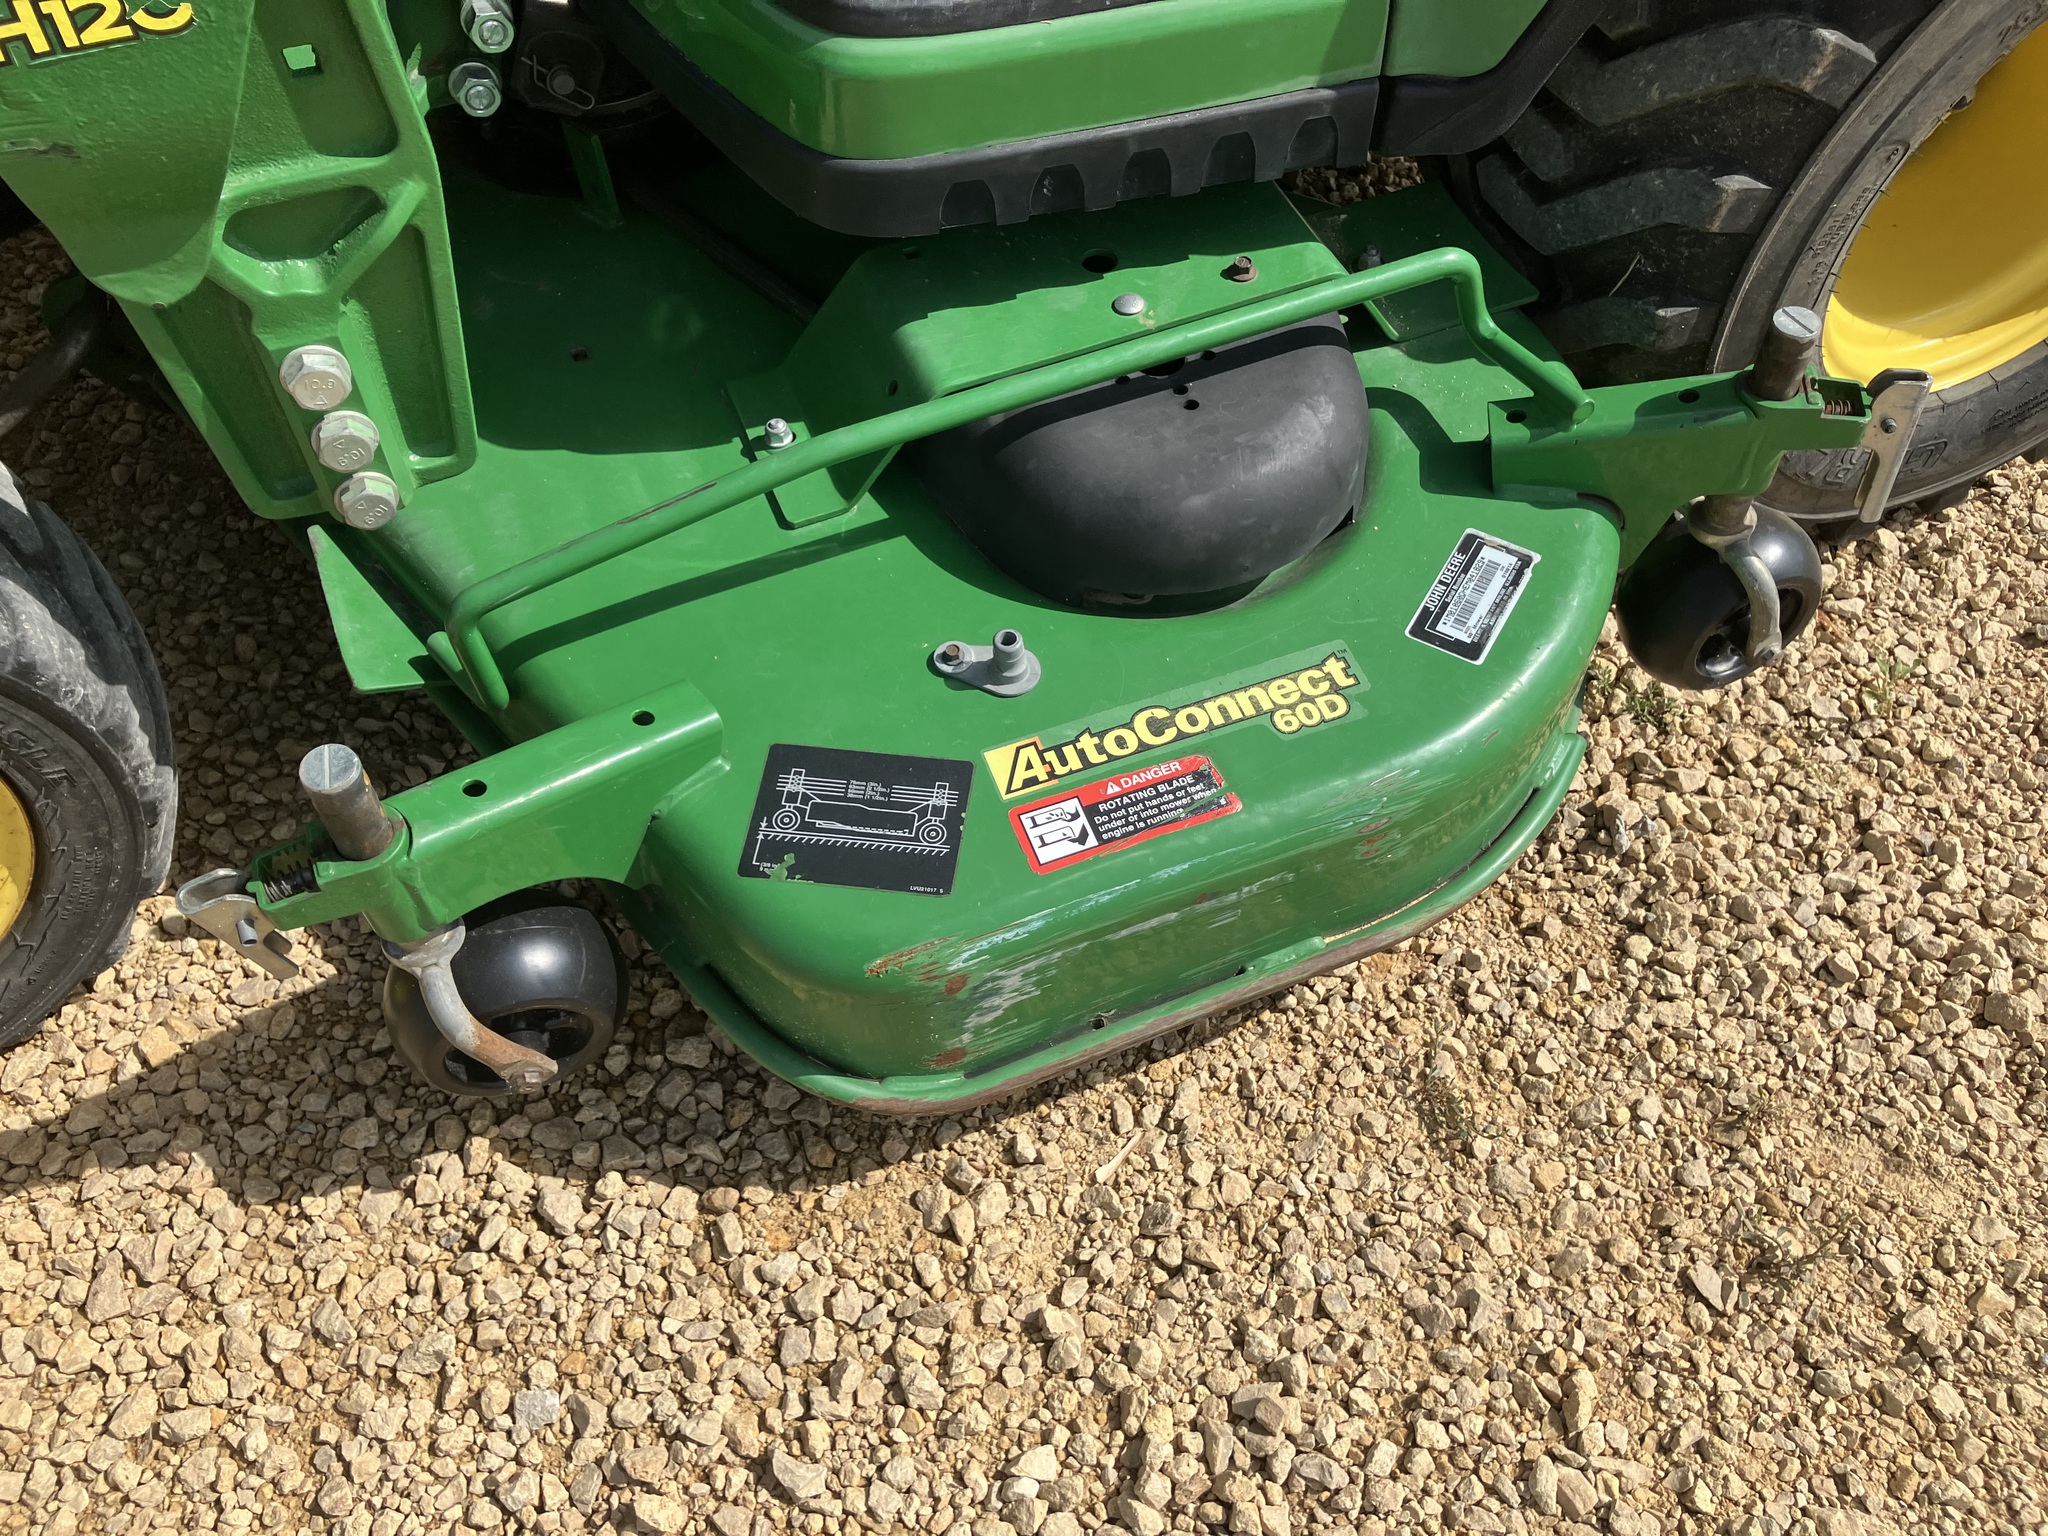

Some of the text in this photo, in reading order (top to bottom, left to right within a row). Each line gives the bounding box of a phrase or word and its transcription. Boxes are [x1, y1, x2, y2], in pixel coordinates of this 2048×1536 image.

[1425, 551, 1466, 611] JOHN DEERE
[1006, 653, 1360, 793] AutoConnect
[1271, 693, 1351, 734] 60D
[0, 728, 78, 788] SLE
[1119, 761, 1183, 789] DANGER
[1094, 782, 1204, 825] Do not put hands or feet
[1099, 775, 1196, 813] ROTATING BLADE
[1099, 820, 1127, 833] under
[1128, 815, 1139, 824] or
[1139, 808, 1159, 821] into
[1160, 798, 1191, 815] mower
[1191, 787, 1218, 802] when
[1101, 808, 1185, 841] engine is running
